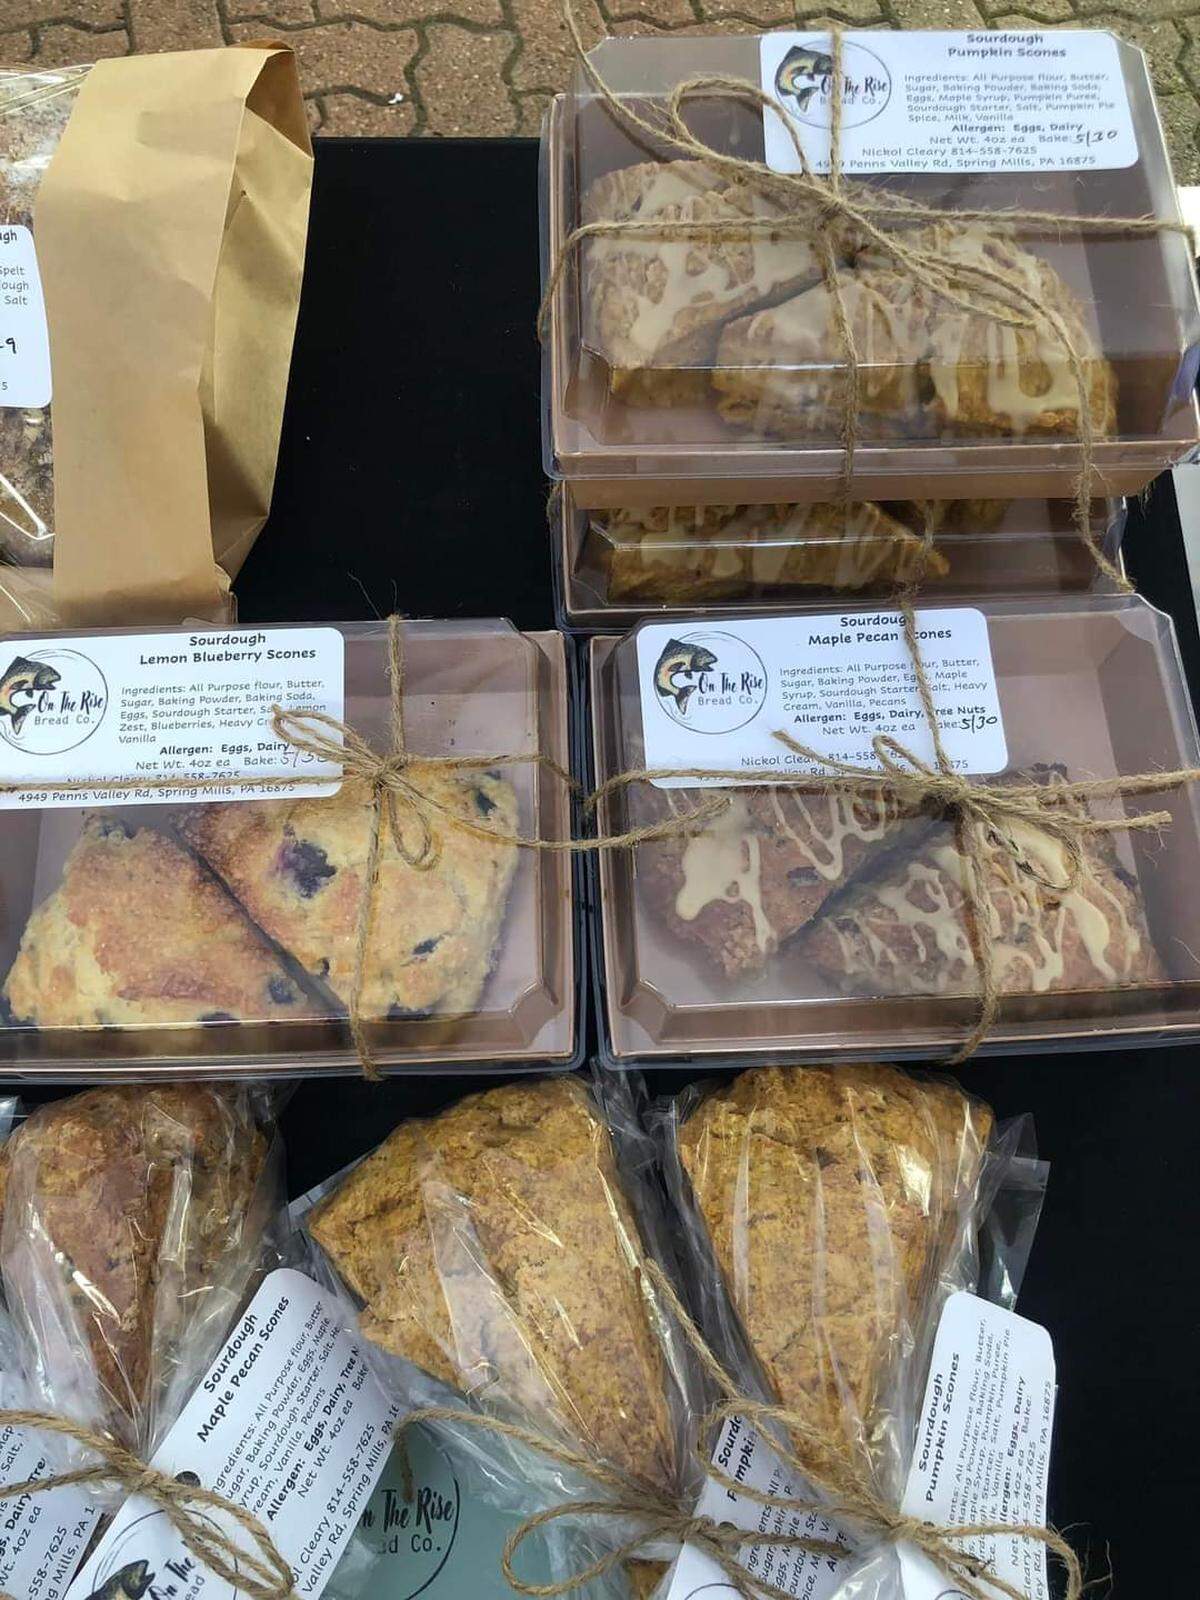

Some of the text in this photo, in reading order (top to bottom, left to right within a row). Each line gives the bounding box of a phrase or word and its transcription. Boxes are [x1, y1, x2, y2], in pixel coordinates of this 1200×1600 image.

[967, 34, 1043, 45] Sourdough
[948, 48, 1066, 59] Pumpkin Scones
[865, 76, 887, 97] Rise
[952, 123, 1083, 134] Allergen: Eggs, Dairy
[929, 136, 952, 144] Net
[956, 135, 979, 144] Wt.
[984, 135, 1007, 143] 4oz
[862, 147, 902, 157] Nickol
[907, 147, 946, 158] Cleary
[850, 156, 1095, 169] Penns Valley Rd, Spring Mills, PA 16875
[4, 296, 28, 306] Salt
[840, 614, 911, 628] Sourdoug
[190, 633, 266, 646] Sourdough
[808, 629, 952, 647] Maple Pecan cones
[140, 649, 316, 665] Lemon Blueberry Scones
[780, 666, 843, 677] Ingredients:
[847, 664, 861, 672] All
[864, 662, 907, 673] Purpose
[942, 658, 979, 668] Butter,
[122, 679, 325, 697] Ingredients: All Purpose flour, Butter,
[699, 671, 763, 695] On The Rise
[781, 671, 968, 689] Sugar, Baking Powder, Maple
[121, 692, 316, 709] Sugar, Baking Powder, Baking Soda,
[698, 696, 758, 705] Bread Co.
[782, 691, 816, 701] Syrup,
[820, 687, 877, 699] Sourdough
[930, 683, 952, 692] alt,
[954, 682, 988, 692] Heavy
[38, 690, 103, 715] On The Rise
[784, 698, 907, 712] Cream, Vanilla, Pecans
[34, 714, 94, 725] Bread Co.
[120, 712, 148, 721] Eggs,
[152, 708, 210, 720] Sourdough
[214, 706, 256, 716] Starter,
[794, 706, 986, 724] Allergen: Eggs, Dairy, ree Nuts
[119, 723, 148, 732] Zest,
[151, 720, 215, 730] Blueberries,
[219, 718, 253, 729] Heavy
[822, 726, 846, 735] Net
[849, 725, 871, 734] Wt.
[875, 724, 897, 732] 4oz
[119, 735, 157, 744] Vanilla
[159, 742, 290, 757] Allergen: Eggs, Dairy
[135, 755, 277, 771] Net Wt. 4oz ea Bake:
[741, 755, 780, 767] Nickol
[19, 792, 48, 803] 4949
[52, 789, 89, 802] Penns
[93, 789, 130, 802] Valley
[133, 788, 153, 800] Rd,
[158, 786, 198, 799] Spring
[202, 785, 235, 797] Mills,
[240, 785, 256, 795] PA
[203, 1313, 258, 1393] Sourdough
[196, 1296, 290, 1443] Maple Pecan Scones
[212, 1332, 310, 1493] ngredients: All Purpose flour,
[225, 1318, 331, 1499] ugar, Baking Powder, Eggs, Maple
[1007, 1377, 1026, 1457] Eggs, Dairy
[239, 1339, 335, 1508] yrup, Sourdough Starter, Salt,
[274, 1388, 326, 1472] Vanilla, Pecans
[918, 1373, 942, 1472] Sourdough
[926, 1352, 959, 1502] Pumpkin Scones
[266, 1357, 356, 1520] Allergen: Eggs, Dairy, Tree
[297, 1399, 353, 1498] Net Wt. 4oz ea
[300, 1423, 375, 1564] Cleary 814-558-7625
[5, 1491, 32, 1530] Dairy
[302, 1420, 393, 1592] Valley Rd, Spring Mills, PA
[381, 1487, 454, 1534] The Rise
[13, 1506, 42, 1554] 4oz ea
[52, 1519, 89, 1584] Mills, PA
[411, 1534, 440, 1552] Co.
[163, 1558, 196, 1582] The
